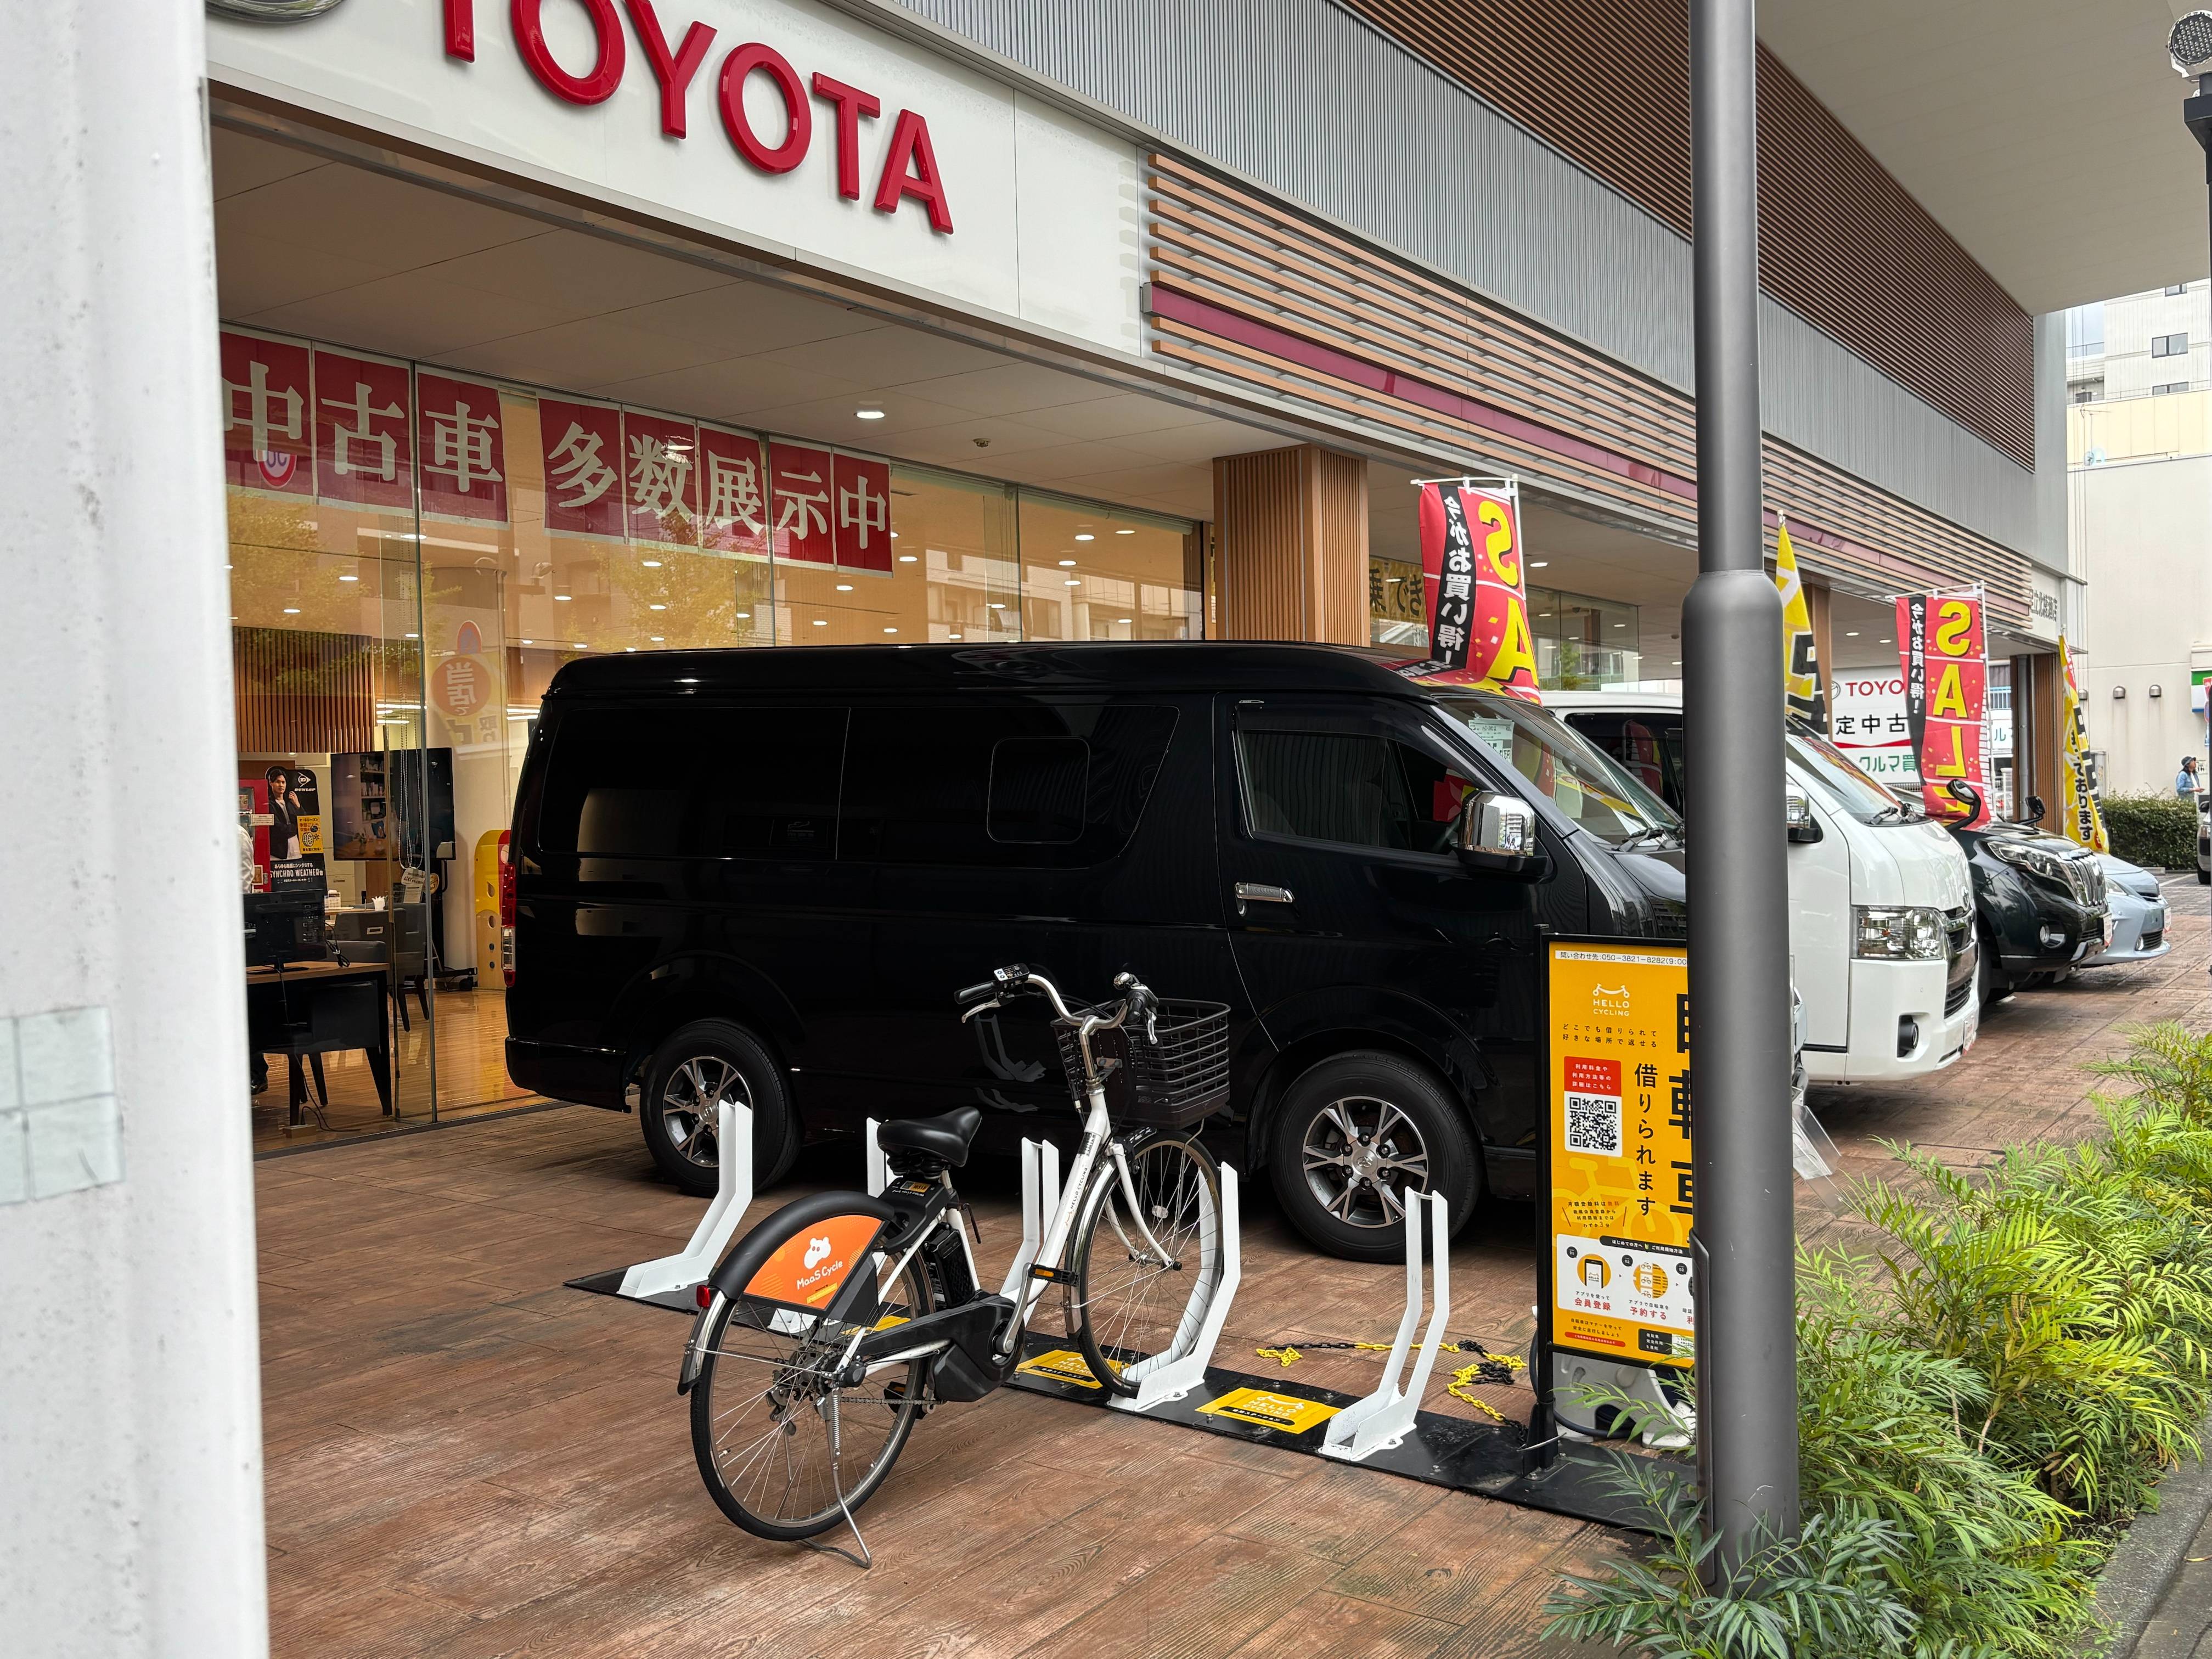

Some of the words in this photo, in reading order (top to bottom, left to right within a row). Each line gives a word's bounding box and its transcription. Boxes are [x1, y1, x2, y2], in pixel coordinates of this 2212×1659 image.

[222, 361, 503, 493] 中古車
[548, 421, 887, 549] 多数展示中
[1845, 679, 1905, 696] TOYO
[1836, 713, 1909, 735] 定中古
[295, 868, 320, 877] WEATHER
[1593, 999, 1630, 1009] HELLO
[1593, 1009, 1630, 1017] CYCLING
[1563, 1023, 1657, 1037] どこでも借りられて
[1562, 1034, 1657, 1048] 好きな場所で返せる
[1634, 1062, 1658, 1216] 借りられます
[1071, 1191, 1079, 1210] HELLO
[1077, 1167, 1088, 1190] CYCLING
[796, 1269, 821, 1290] MaaS
[821, 1260, 843, 1276] Cycle
[1574, 1297, 1611, 1311] 会員登録
[1630, 1306, 1667, 1320] 予約する
[1058, 1360, 1089, 1369] HELL
[1242, 1404, 1291, 1417] CYCLING
[1248, 1399, 1297, 1414] HELLO
